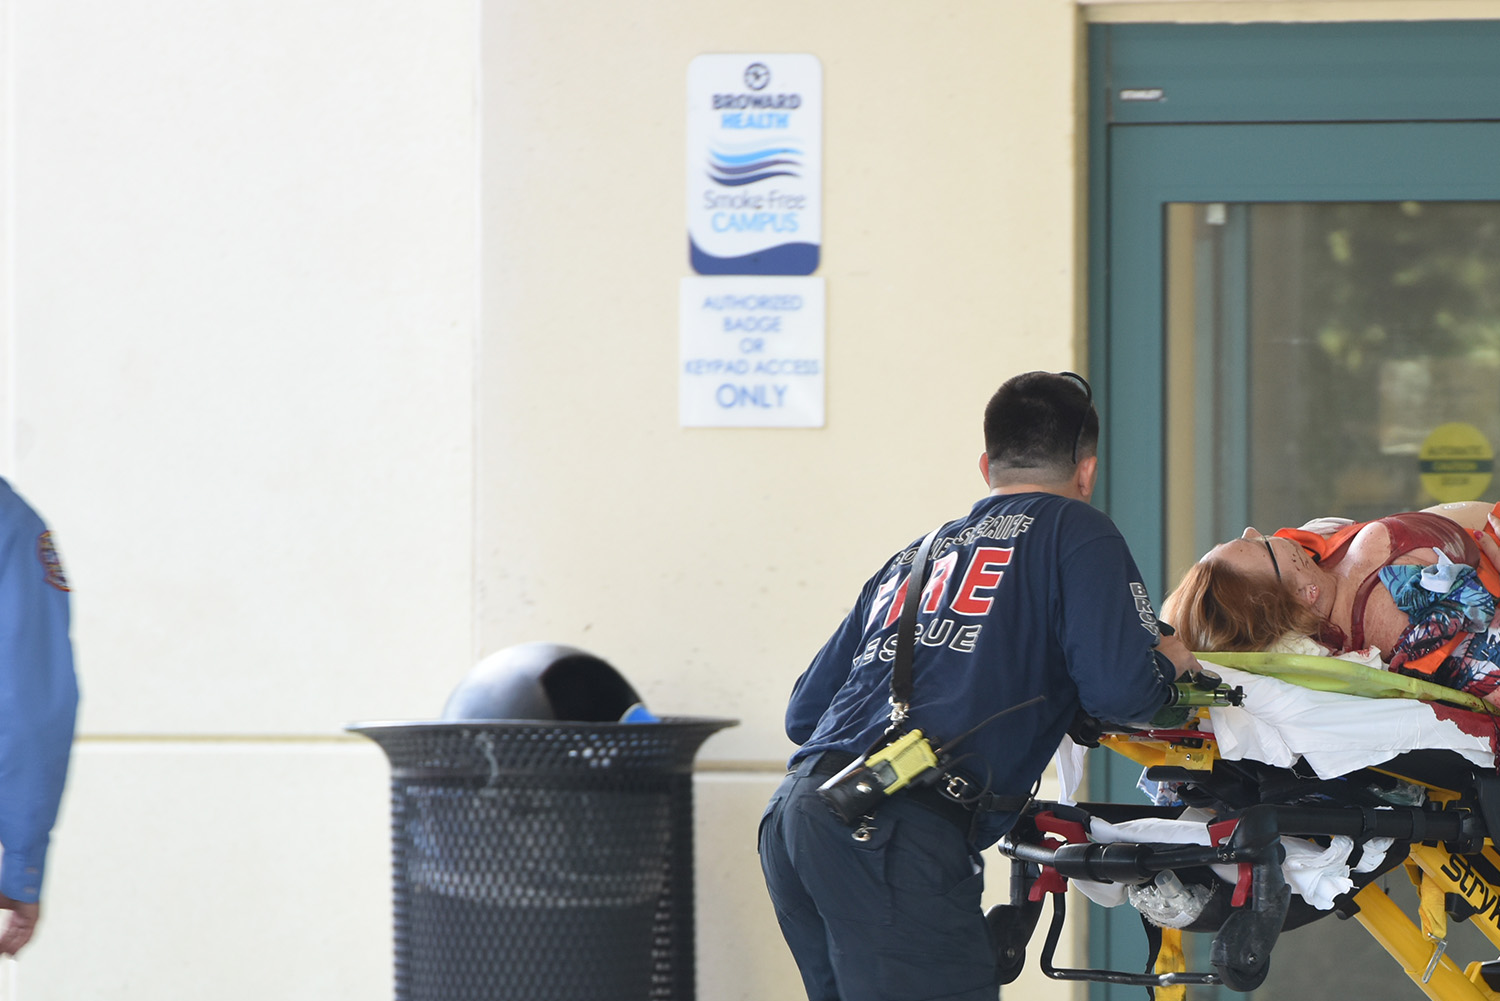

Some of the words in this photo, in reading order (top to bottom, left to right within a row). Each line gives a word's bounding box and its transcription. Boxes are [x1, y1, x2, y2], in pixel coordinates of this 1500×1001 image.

[712, 93, 802, 110] BROWARD
[721, 112, 789, 129] HEALTH
[703, 190, 763, 210] Smoke
[767, 189, 807, 210] Free
[711, 211, 800, 233] CAMPUS
[702, 294, 804, 311] AUTHORIZED
[723, 315, 782, 332] BADGE
[739, 337, 766, 354] OR
[685, 358, 749, 375] KEYPAD
[755, 358, 820, 375] ACCESS
[715, 382, 789, 408] ONLY
[864, 546, 1015, 633] FIRE
